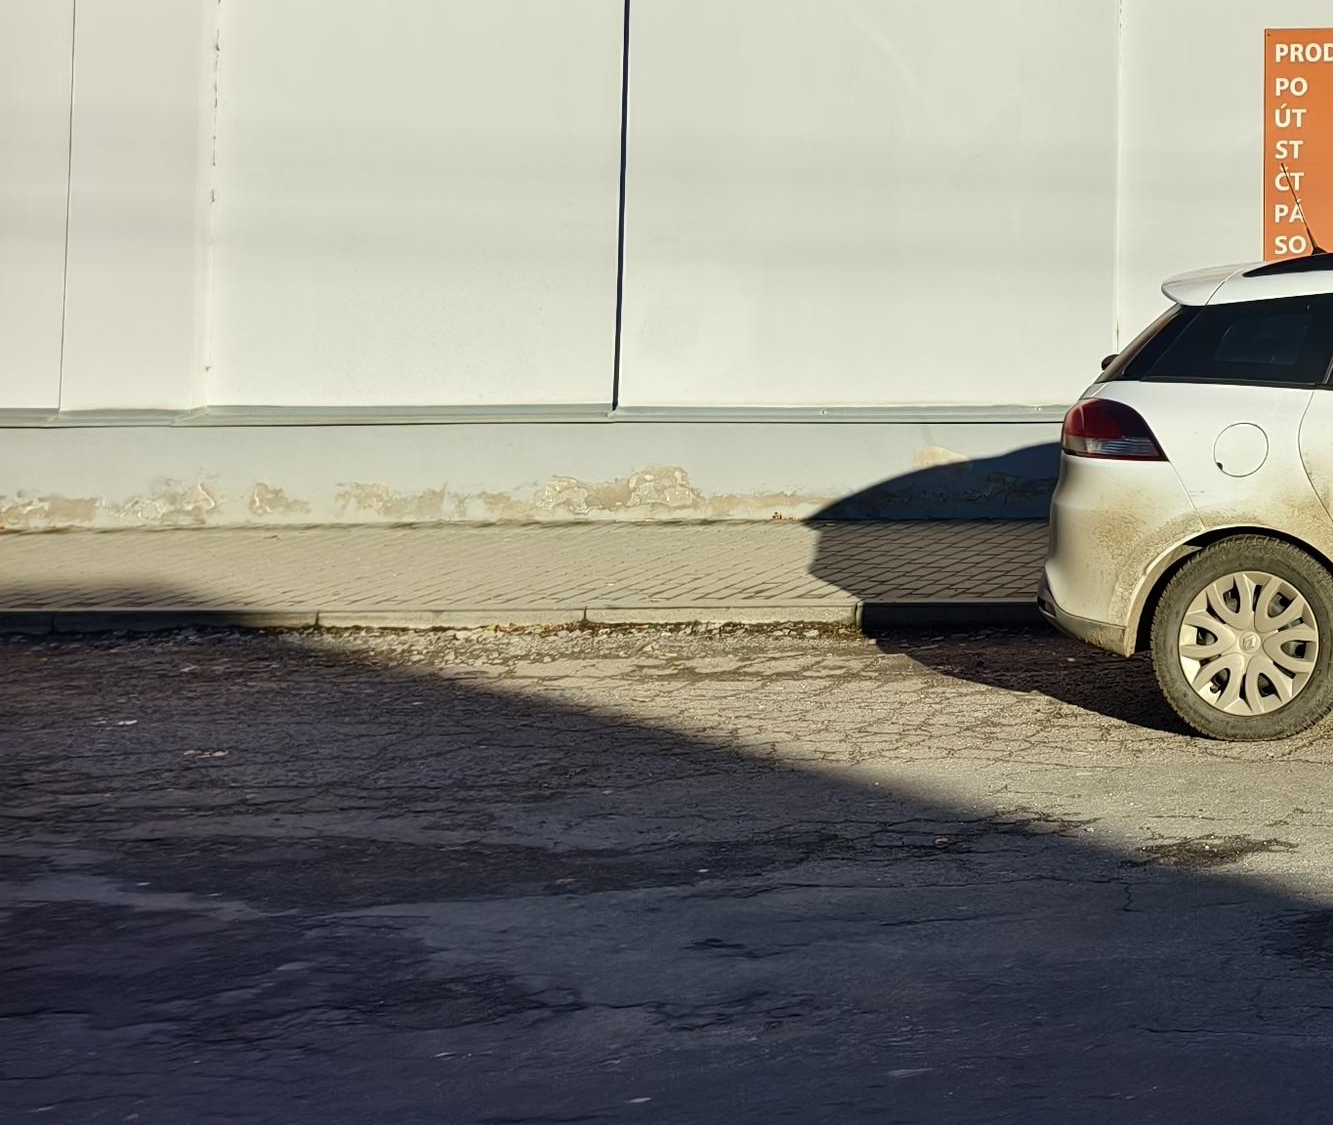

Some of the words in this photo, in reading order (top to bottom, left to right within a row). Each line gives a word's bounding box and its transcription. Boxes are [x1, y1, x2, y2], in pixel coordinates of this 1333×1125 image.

[1274, 76, 1308, 97] PO
[1273, 103, 1307, 128] ÚT
[1274, 139, 1304, 160] ST
[1274, 166, 1305, 192] ČT
[1274, 198, 1304, 224] PÁ
[1274, 234, 1307, 255] SO
